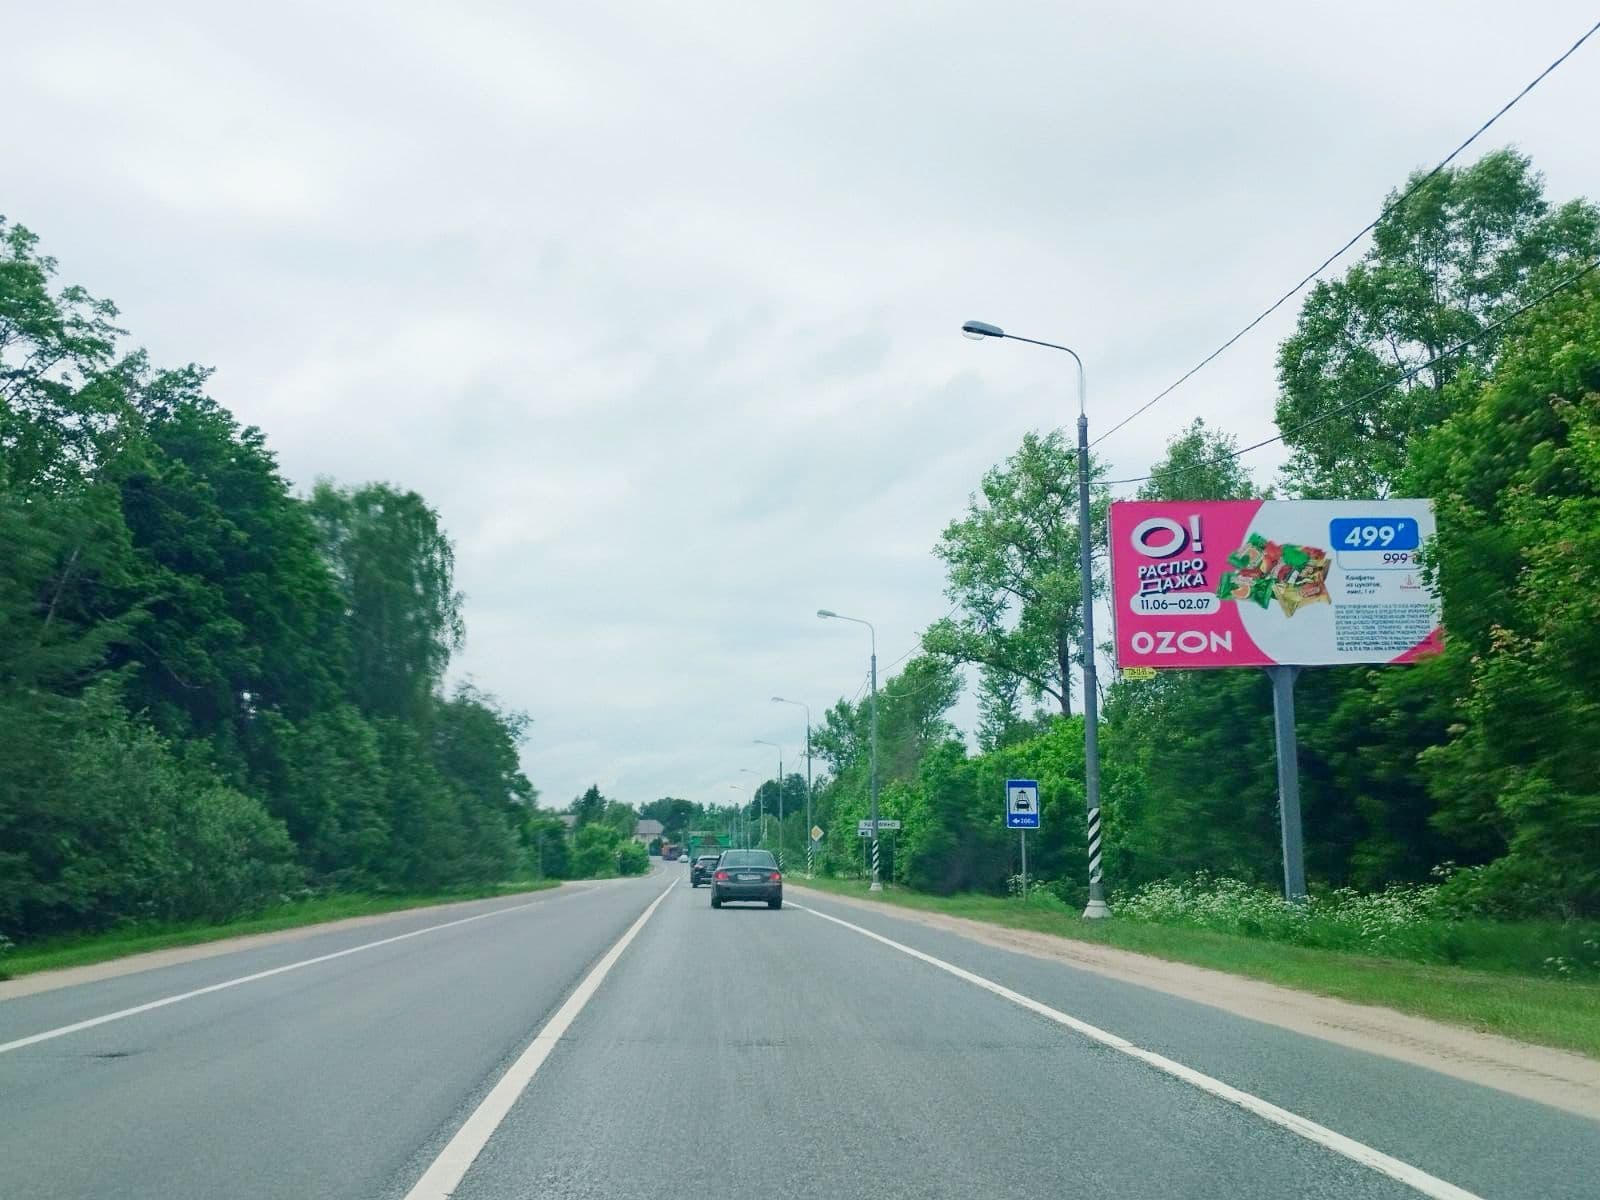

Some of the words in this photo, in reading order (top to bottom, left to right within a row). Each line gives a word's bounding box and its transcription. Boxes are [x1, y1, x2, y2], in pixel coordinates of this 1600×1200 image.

[1138, 558, 1204, 578] РАСПРО
[1139, 573, 1205, 594] ДАЖА
[1131, 630, 1233, 654] OZON
